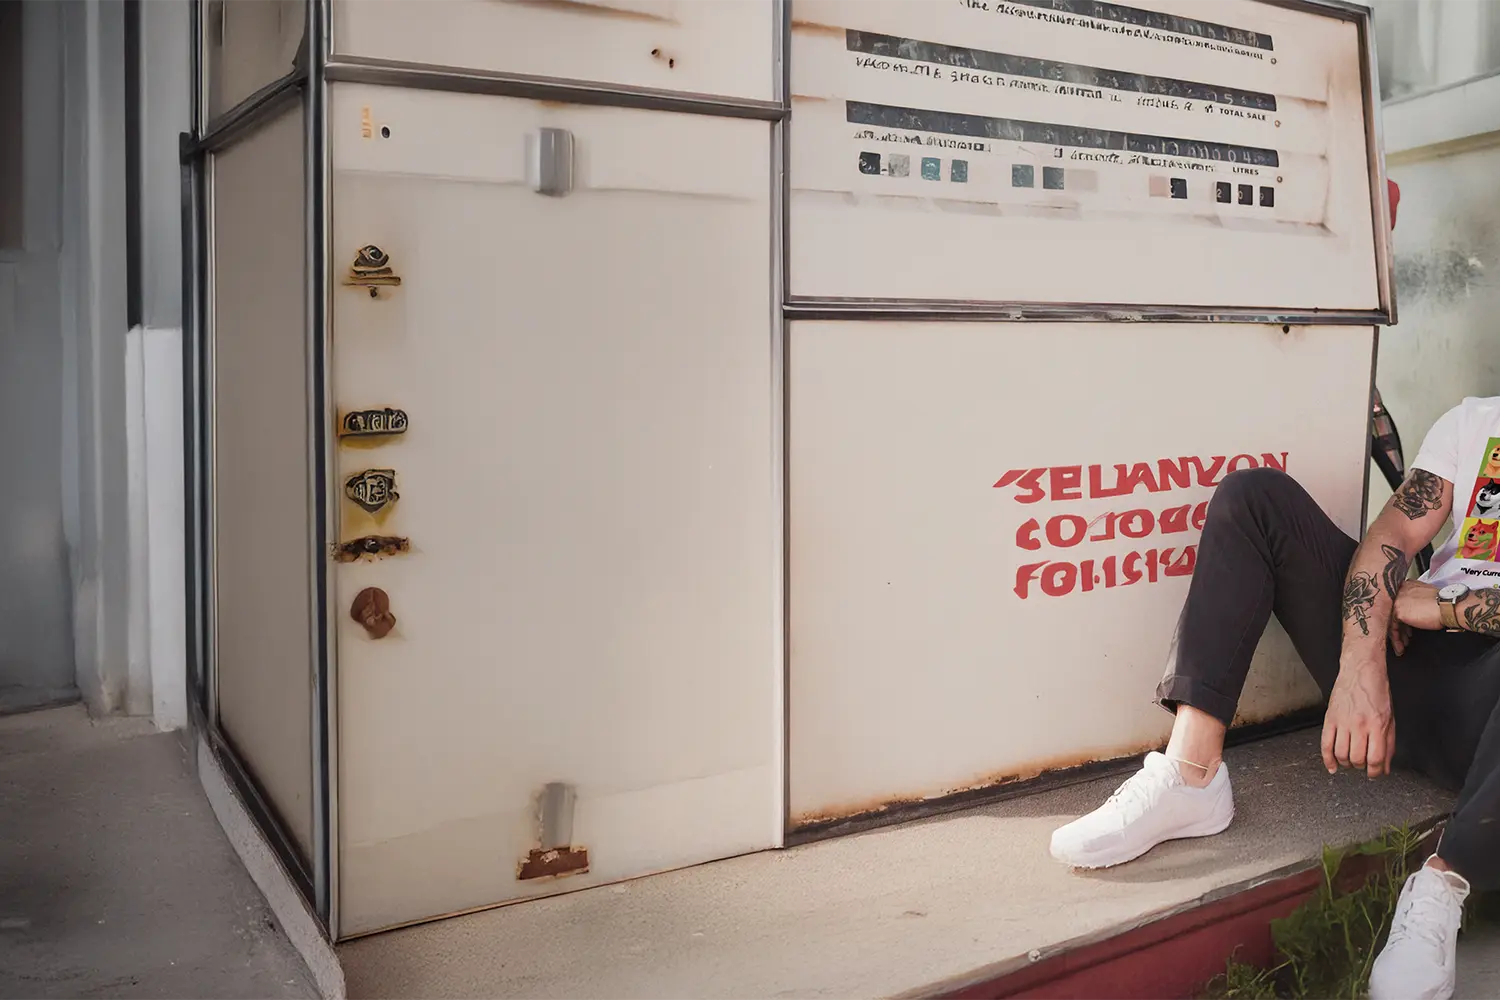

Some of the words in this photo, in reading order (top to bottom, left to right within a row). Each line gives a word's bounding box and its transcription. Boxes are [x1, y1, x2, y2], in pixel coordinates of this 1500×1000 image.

[1219, 108, 1244, 118] TOTAL
[1247, 112, 1266, 121] SALE
[1232, 166, 1259, 176] LITRES
[1460, 567, 1482, 577] "Very
